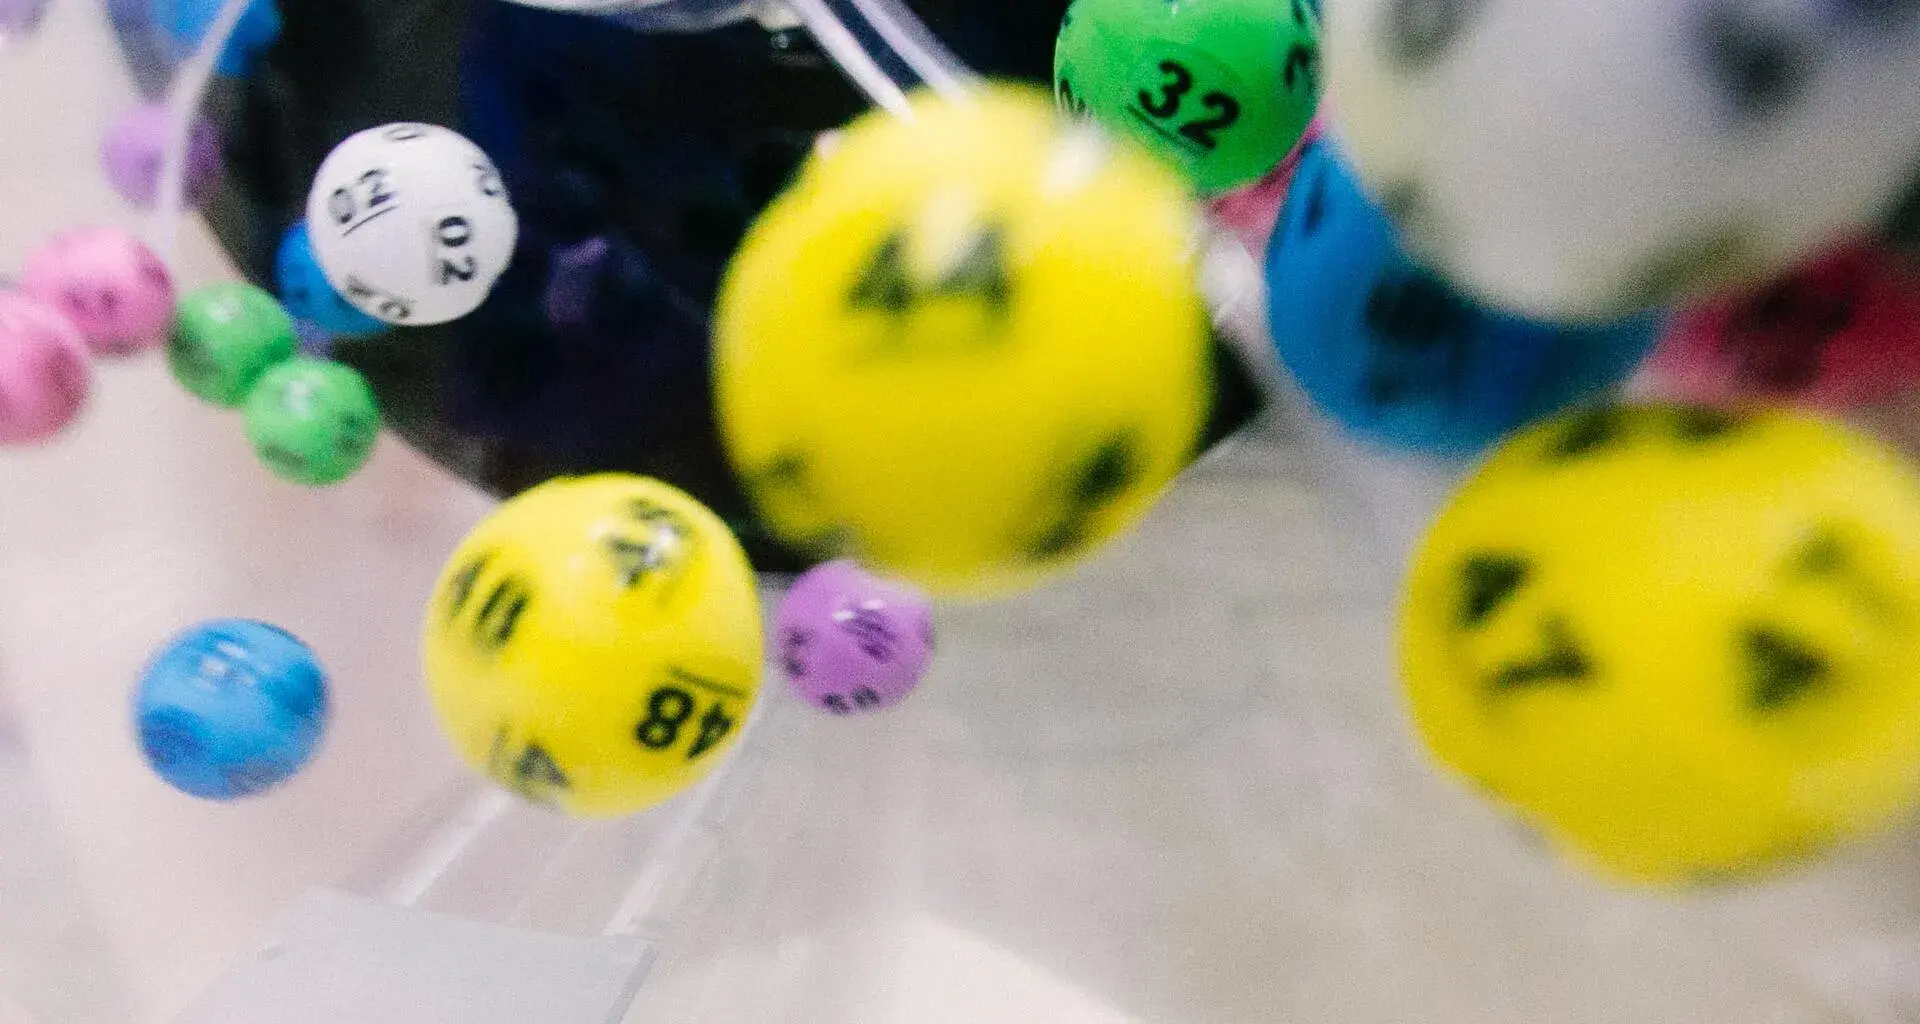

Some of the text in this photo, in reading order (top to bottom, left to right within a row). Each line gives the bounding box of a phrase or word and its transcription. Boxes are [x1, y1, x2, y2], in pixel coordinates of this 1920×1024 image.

[1137, 60, 1241, 149] 32
[436, 215, 475, 286] 02
[846, 222, 1014, 327] 44
[1453, 549, 1599, 694] 47
[634, 686, 735, 761] 48
